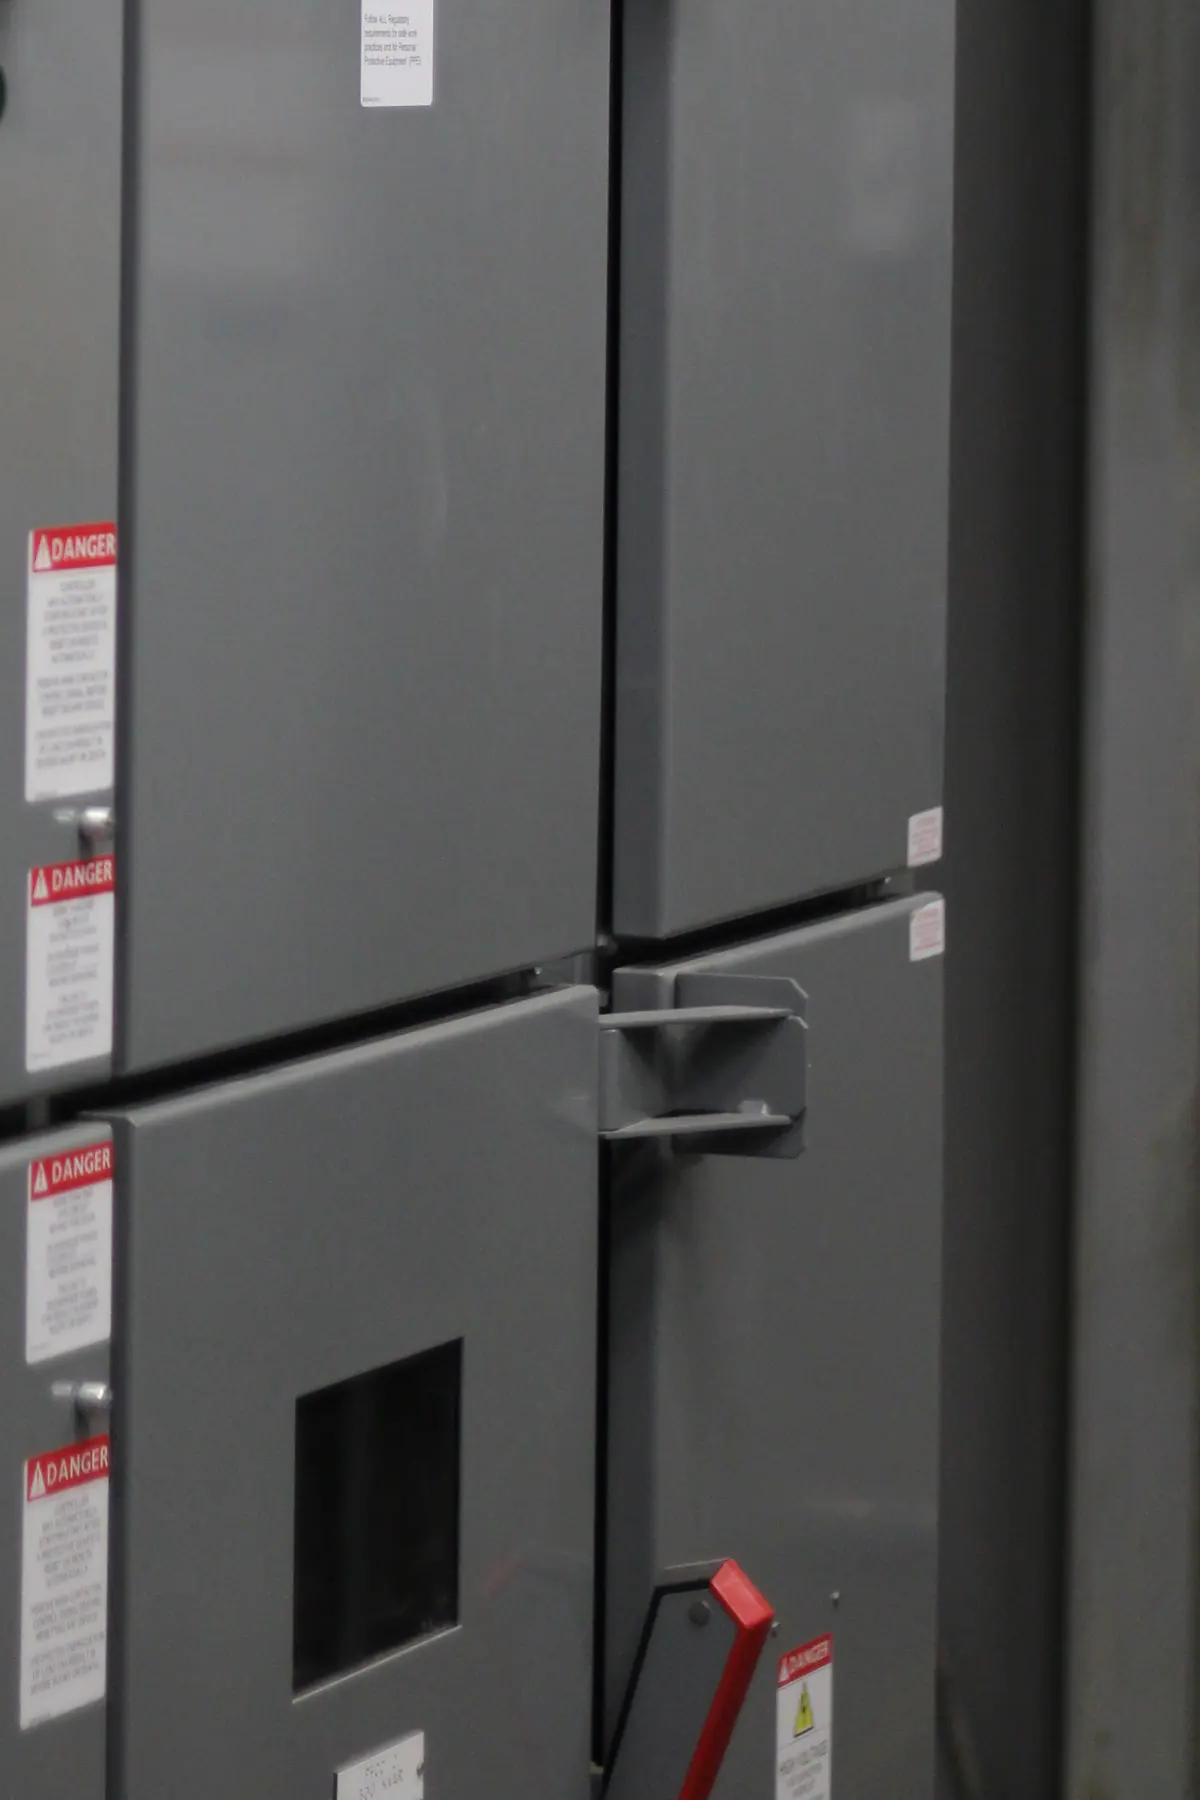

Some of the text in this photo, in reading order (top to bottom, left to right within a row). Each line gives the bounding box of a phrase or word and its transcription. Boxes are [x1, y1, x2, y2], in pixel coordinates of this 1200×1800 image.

[52, 532, 116, 561] DANGER
[52, 860, 113, 892] DANGER
[52, 1148, 111, 1185] DANGER
[47, 1444, 108, 1487] DANGER
